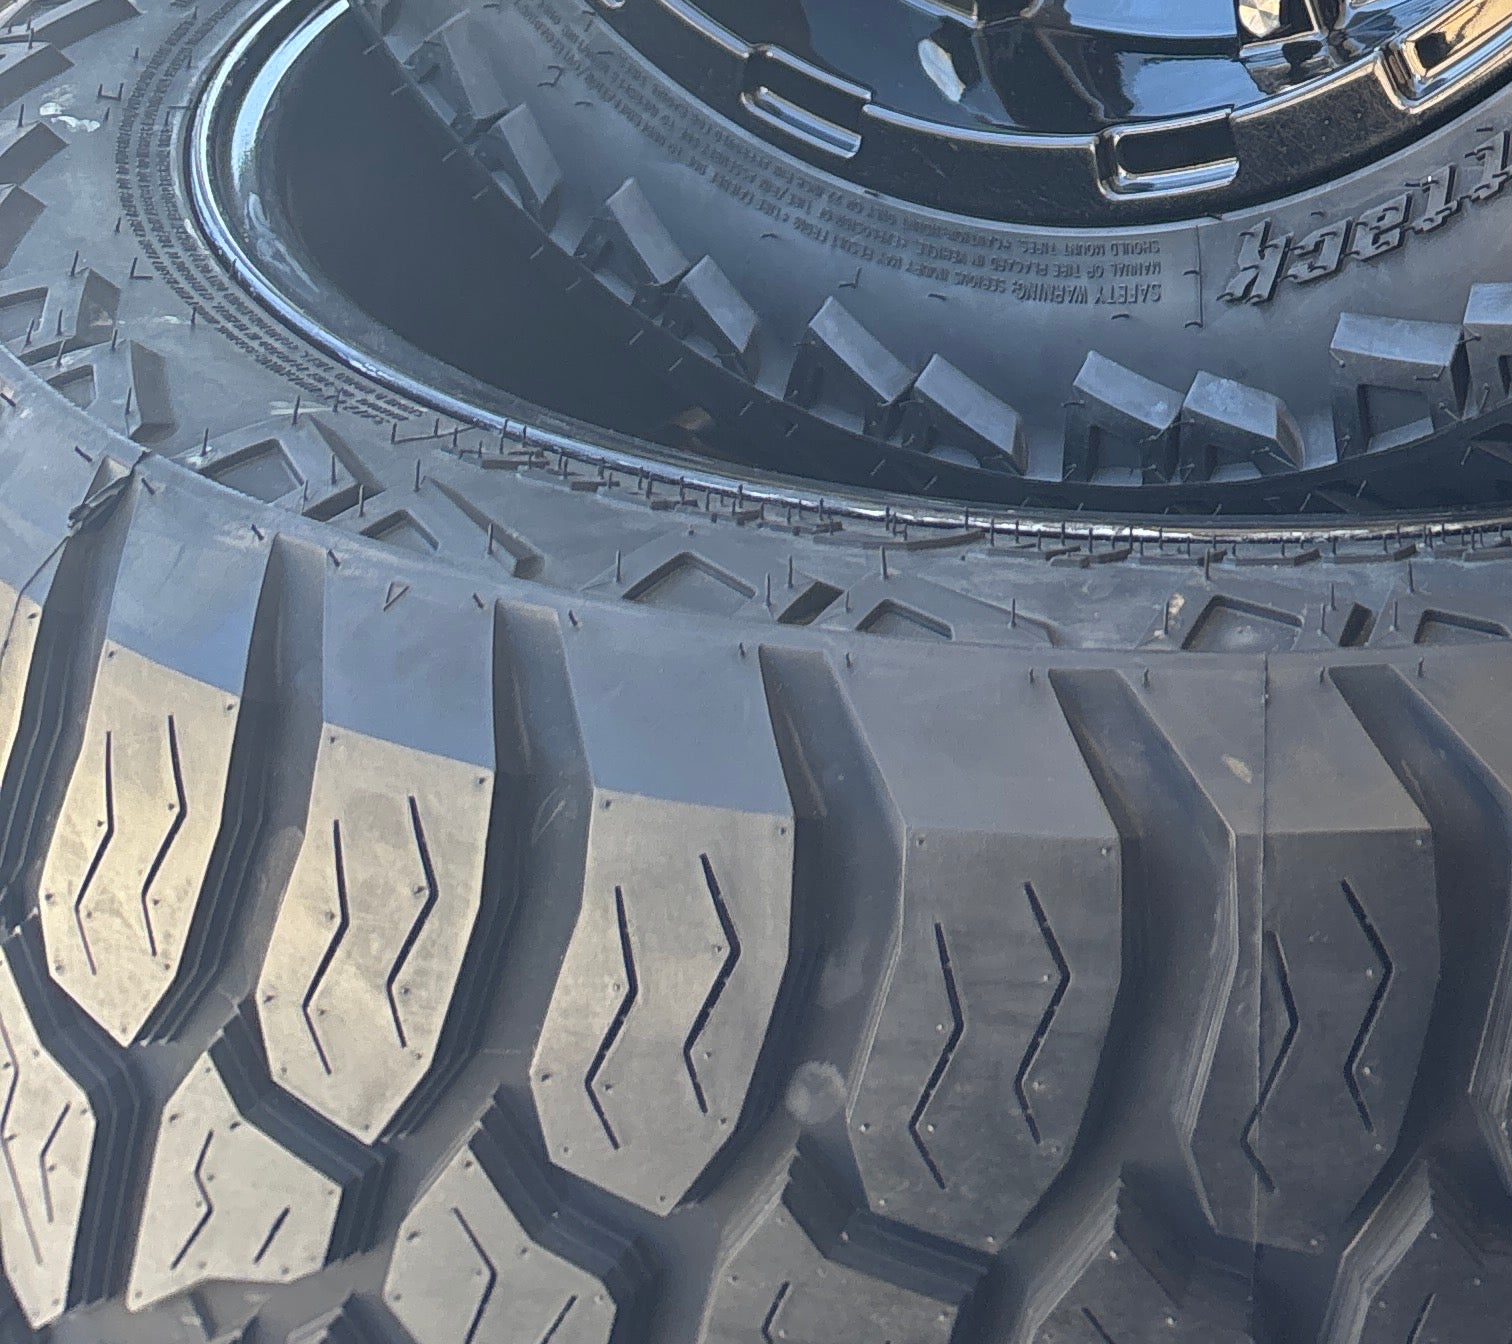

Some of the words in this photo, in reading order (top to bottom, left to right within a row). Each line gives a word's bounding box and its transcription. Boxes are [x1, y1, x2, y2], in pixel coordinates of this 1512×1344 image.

[1110, 238, 1160, 257] SHOULD
[1109, 258, 1161, 279] MANUAL
[1094, 279, 1162, 307] SAFETY
